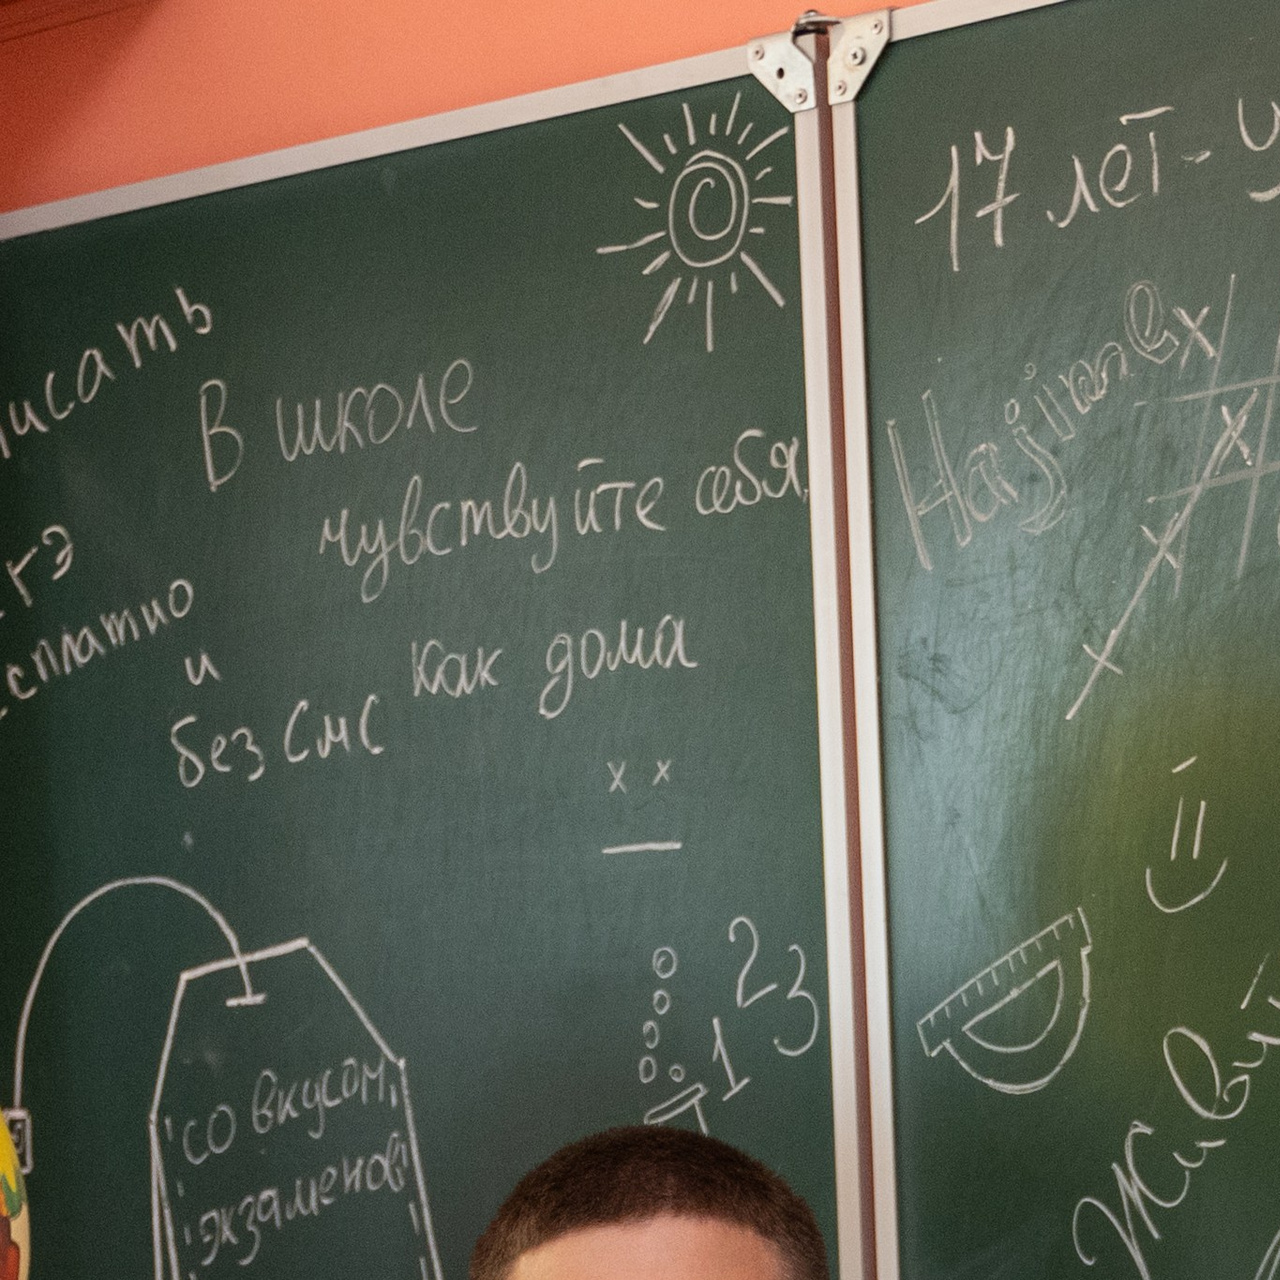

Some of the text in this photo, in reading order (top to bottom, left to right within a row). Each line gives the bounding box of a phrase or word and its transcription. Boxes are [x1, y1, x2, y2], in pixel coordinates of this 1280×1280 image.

[915, 127, 1020, 271] 17
[200, 358, 480, 492] В школе
[0, 578, 194, 720] сплатно
[185, 652, 223, 686] и
[410, 612, 698, 720] как дома
[170, 713, 266, 788] без
[199, 1132, 405, 1267] экзаменов
